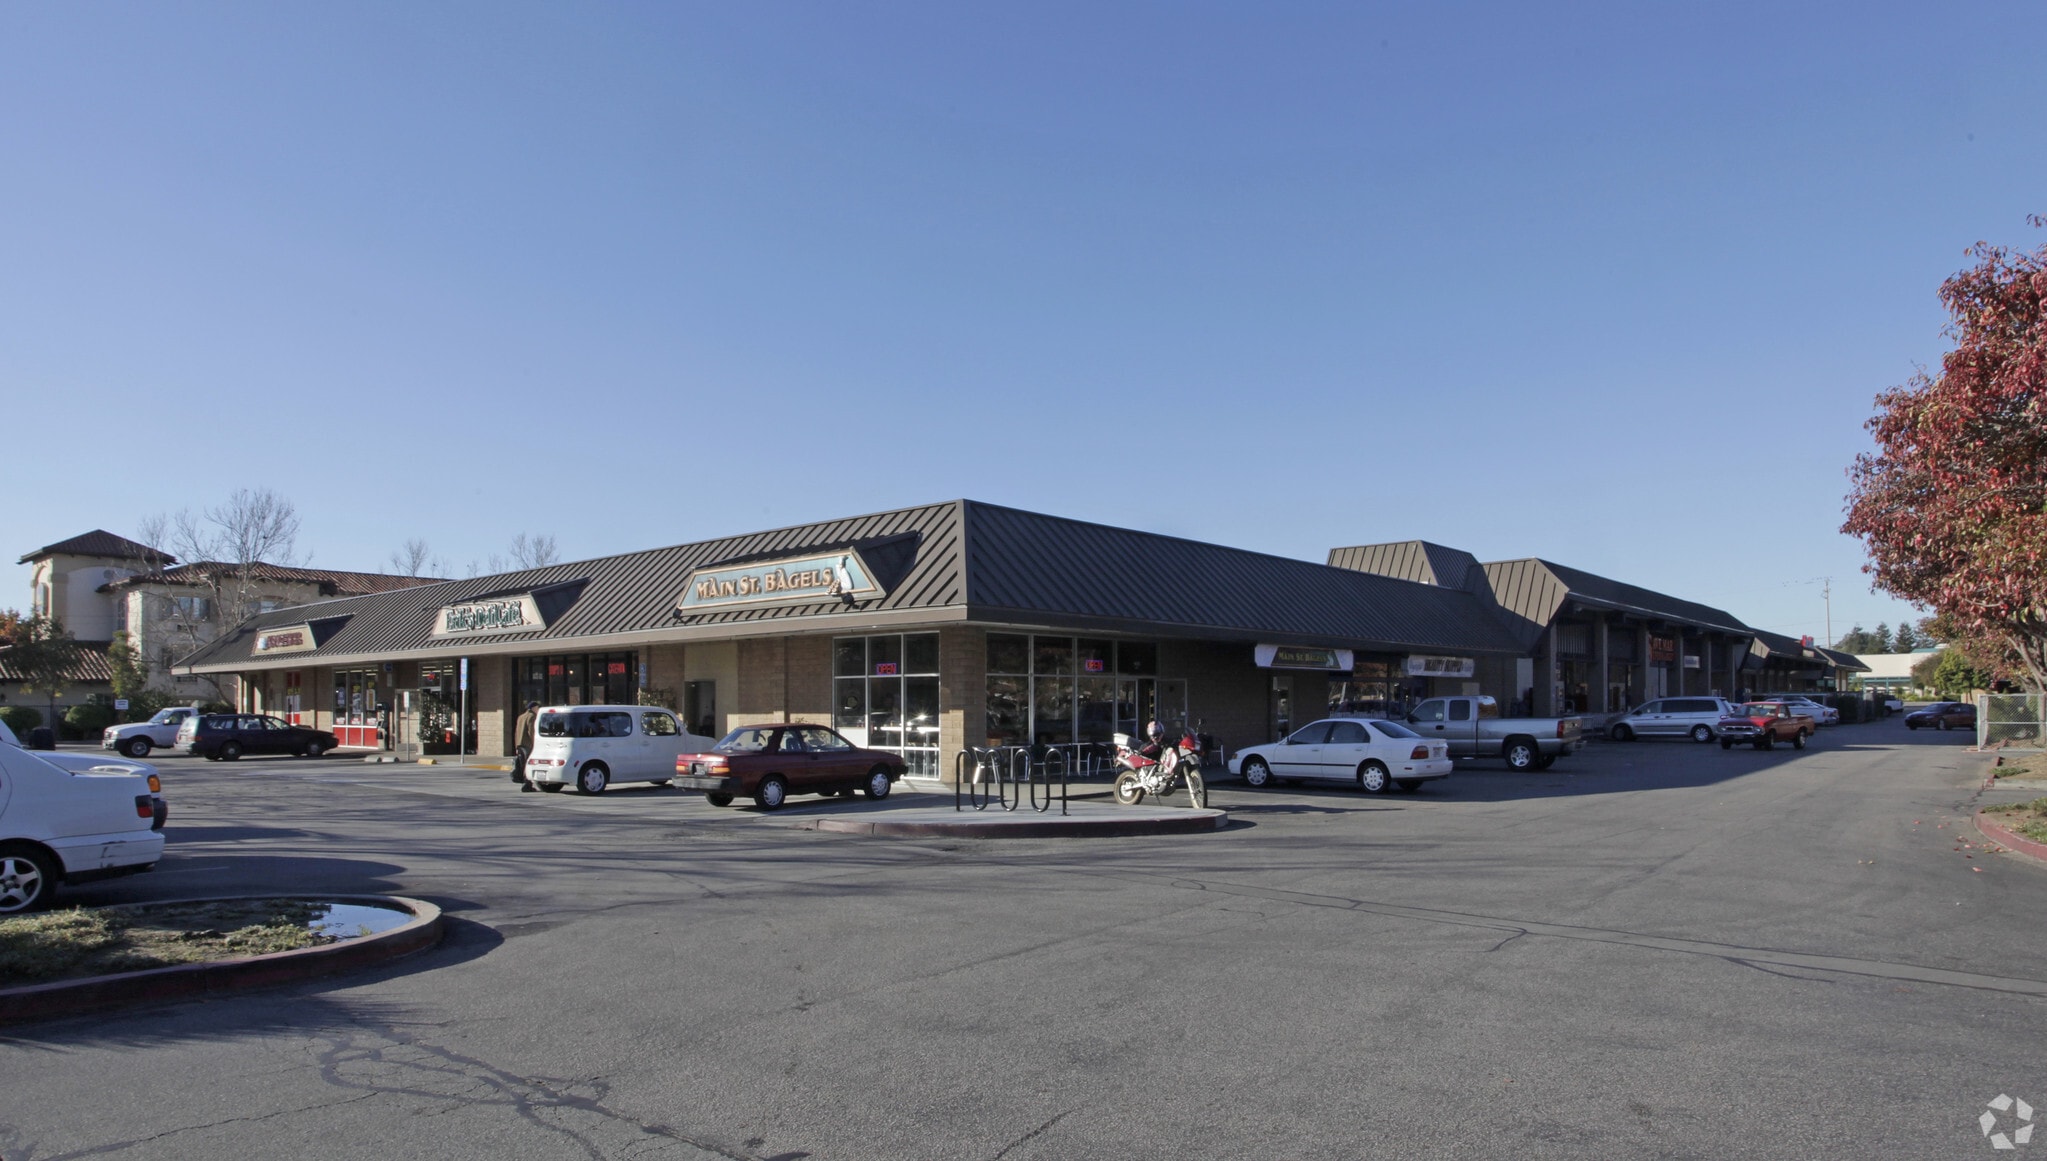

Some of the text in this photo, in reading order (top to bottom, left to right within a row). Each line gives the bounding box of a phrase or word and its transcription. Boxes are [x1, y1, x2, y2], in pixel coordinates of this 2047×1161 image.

[697, 568, 833, 599] MAIN ST. BAGELS
[878, 664, 896, 675] OPEN
